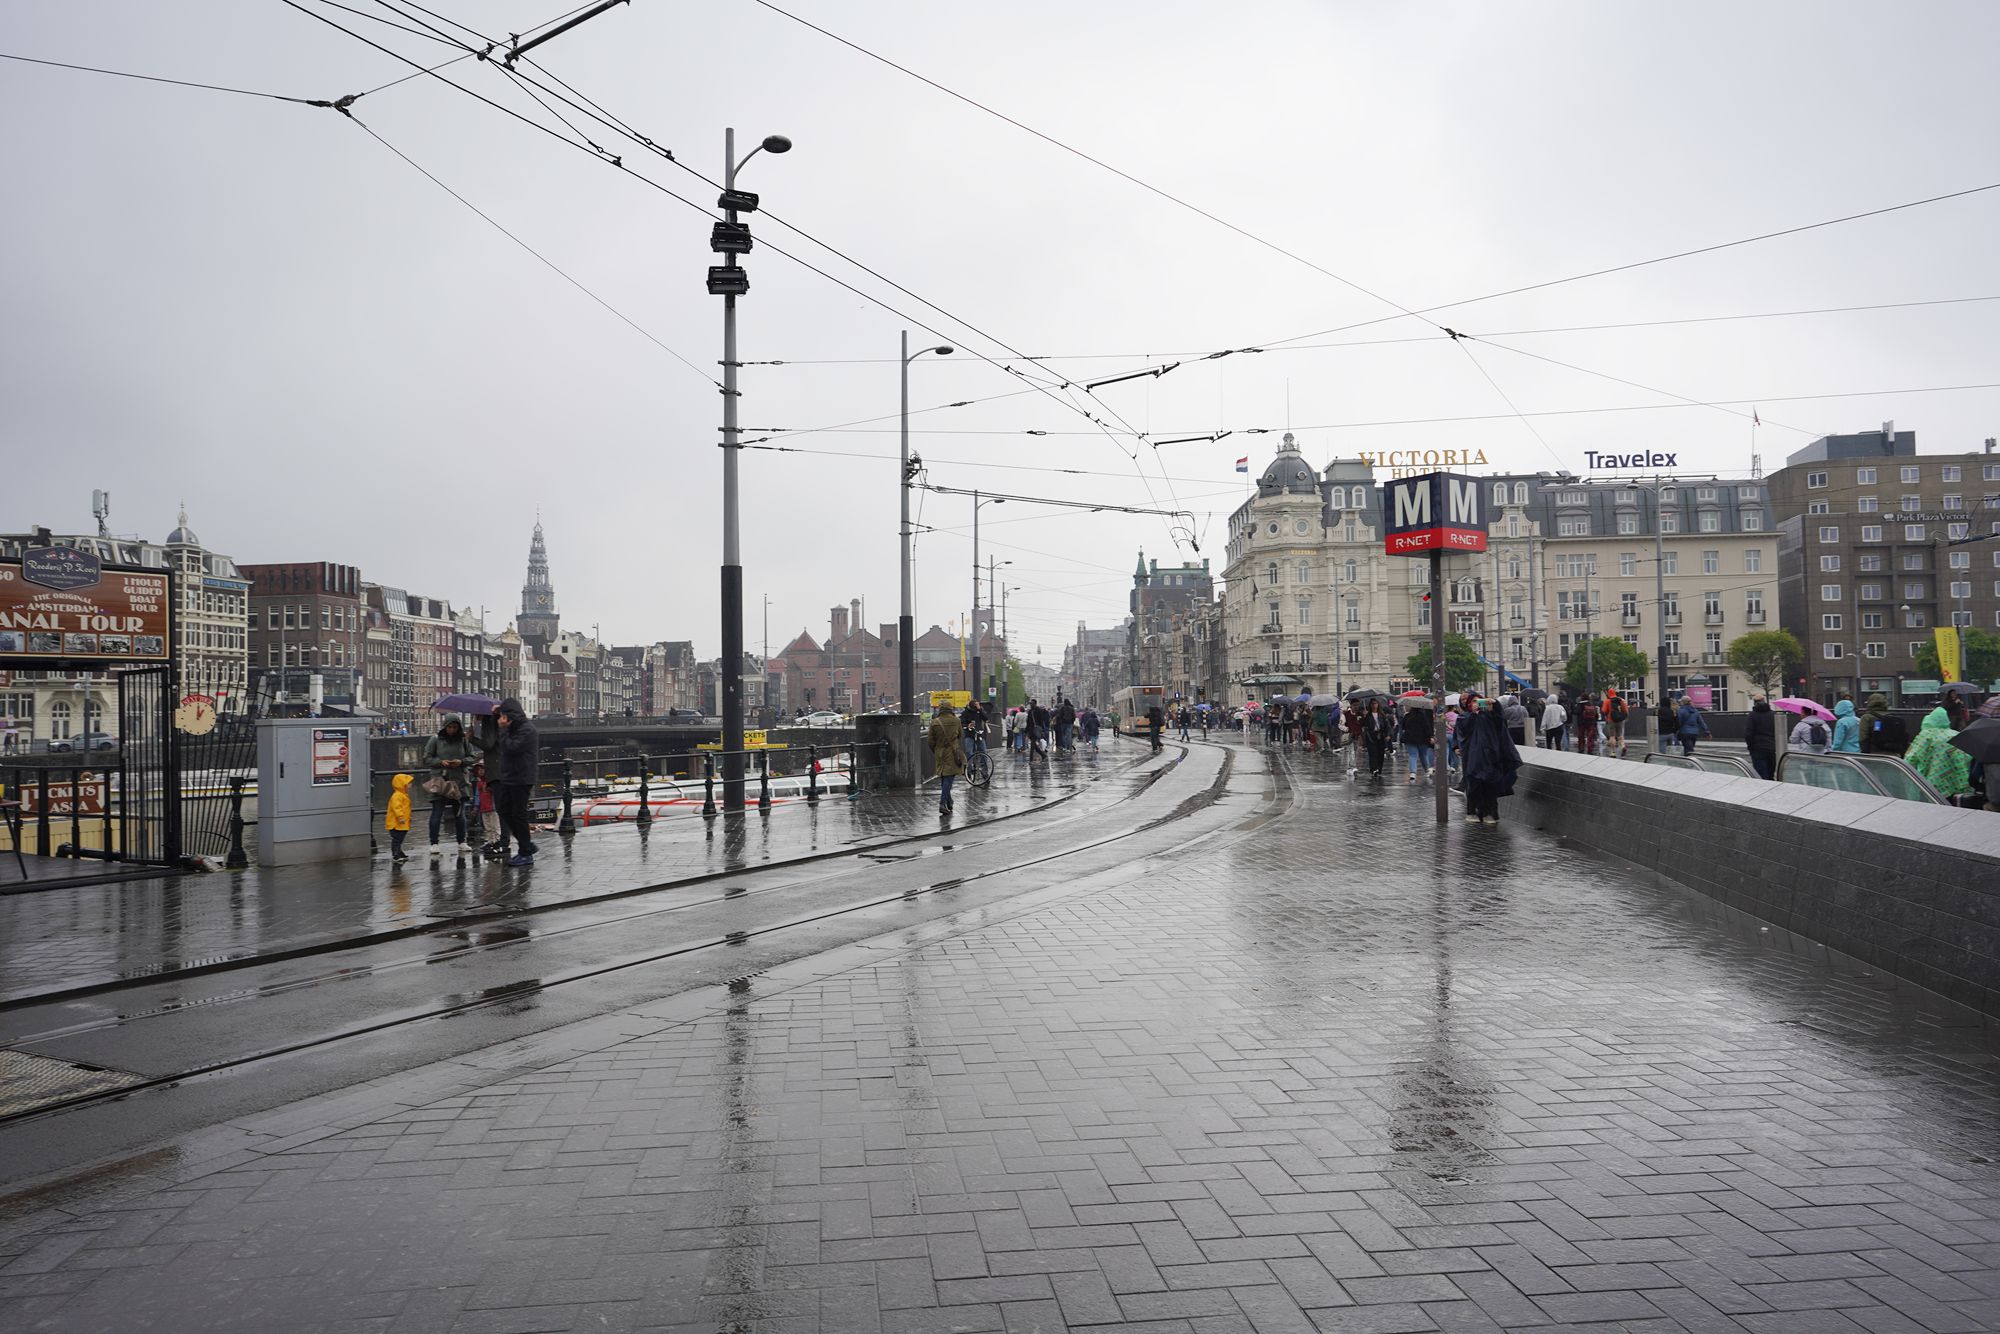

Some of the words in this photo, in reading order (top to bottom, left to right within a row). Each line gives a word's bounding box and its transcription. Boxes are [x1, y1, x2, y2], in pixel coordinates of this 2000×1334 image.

[1358, 448, 1489, 468] VICTORIA
[1584, 449, 1677, 469] Travelex
[1394, 479, 1431, 528] M
[1449, 478, 1478, 525] M
[1896, 513, 1916, 522] Park
[1916, 513, 1940, 521] Plaza
[1939, 512, 1974, 520] Victori
[130, 578, 162, 587] HOUR
[123, 586, 163, 596] GUIDED
[32, 593, 51, 602] THE
[52, 593, 92, 604] ORIGINAL
[129, 595, 157, 604] BOAT
[26, 602, 98, 614] AMSTERDAM
[129, 603, 159, 613] TOUR
[75, 614, 144, 633] TOUR
[31, 785, 96, 799] TCKTS
